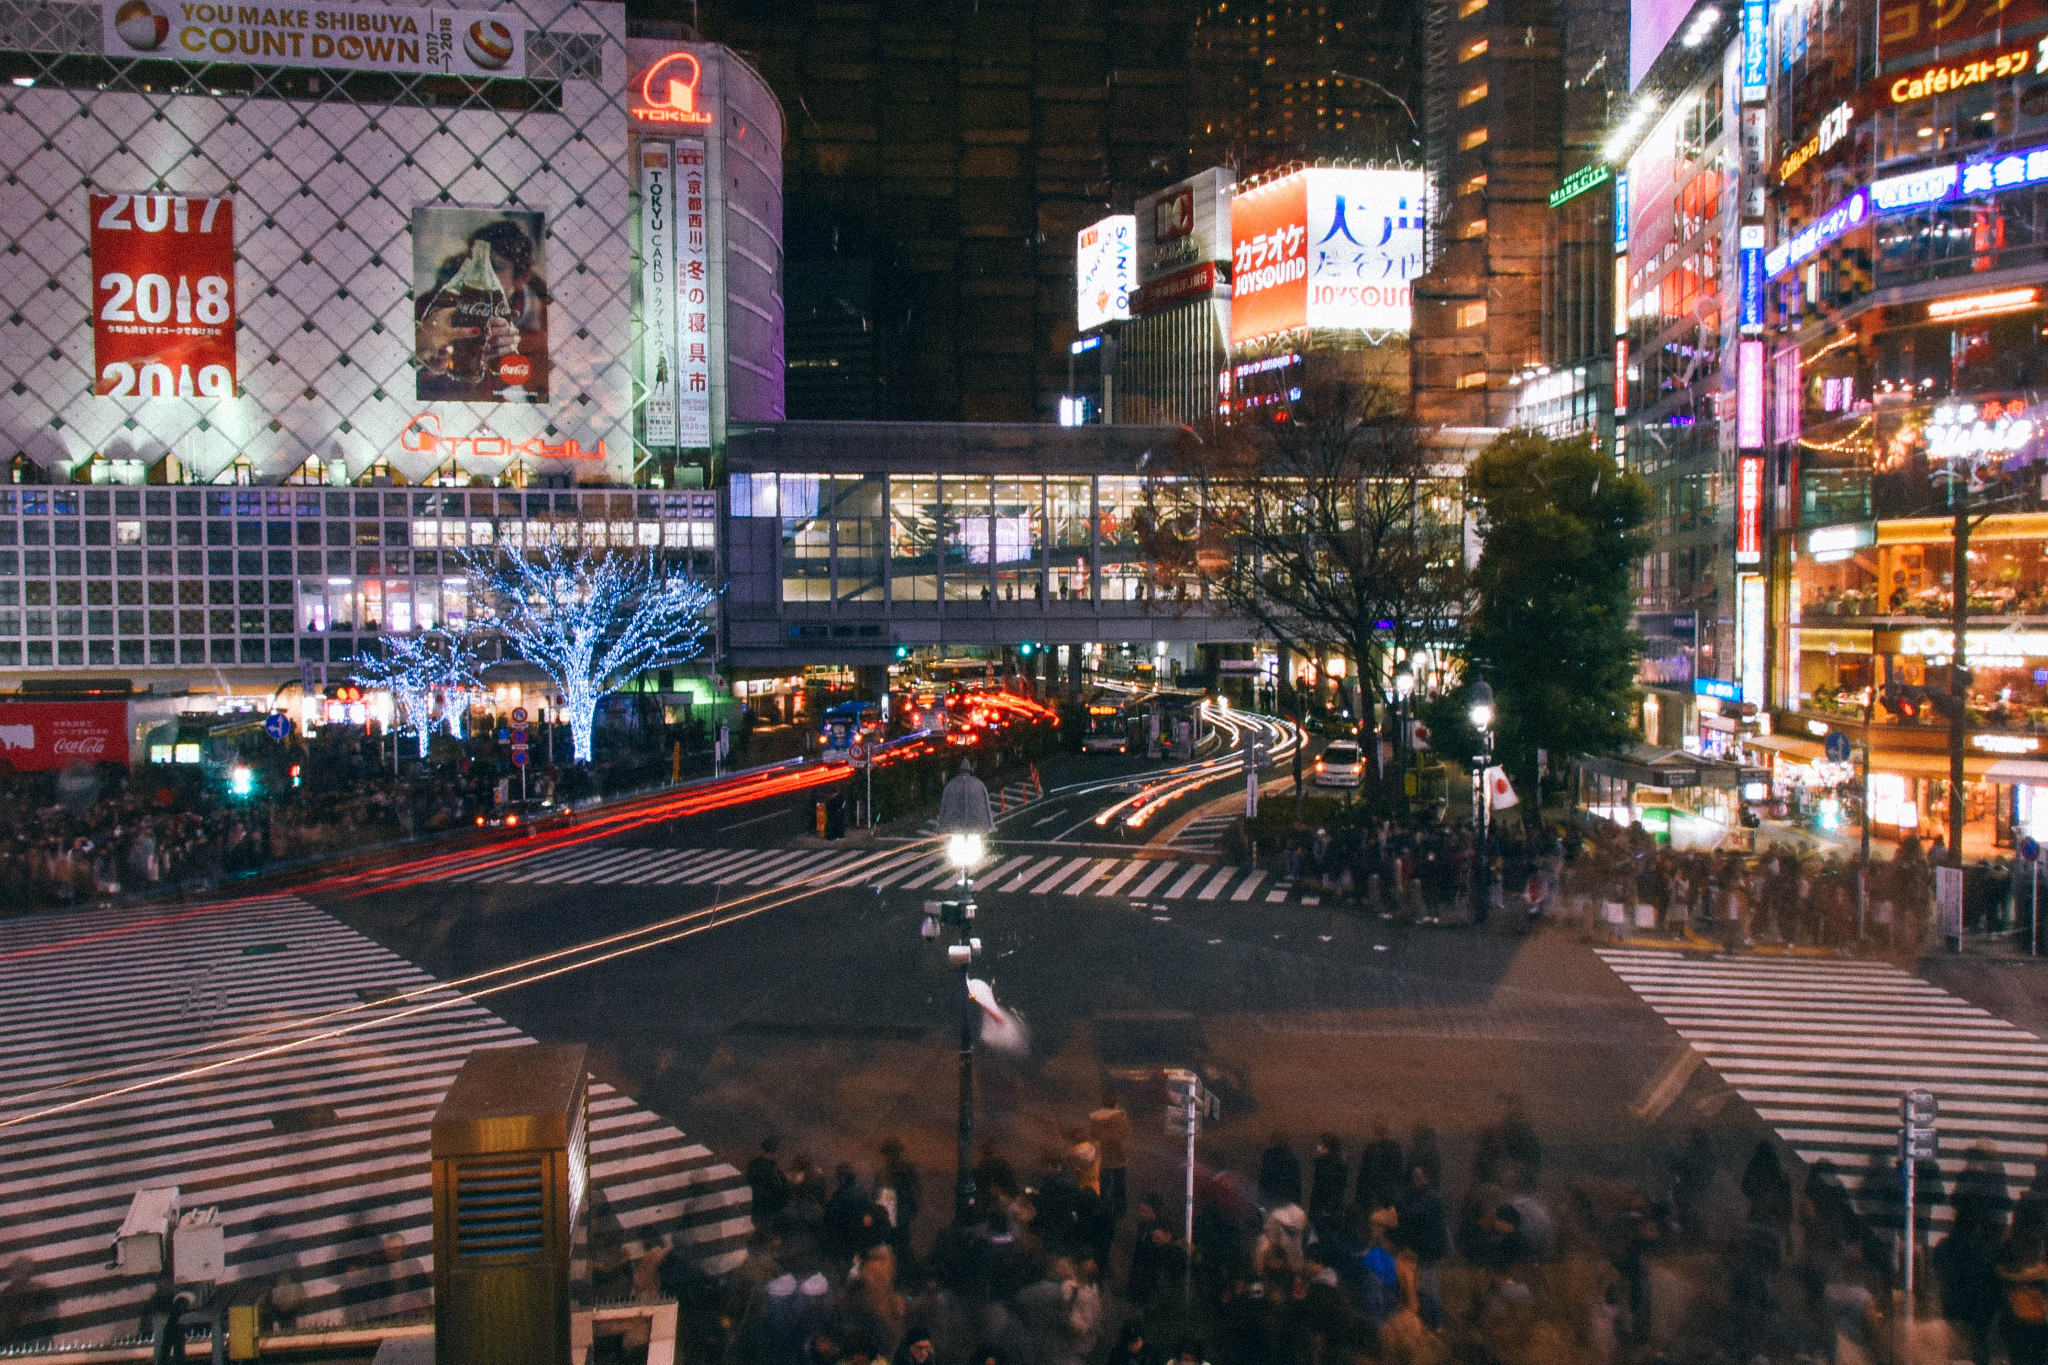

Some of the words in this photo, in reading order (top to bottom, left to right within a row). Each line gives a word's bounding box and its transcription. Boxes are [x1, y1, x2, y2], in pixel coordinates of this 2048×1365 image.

[181, 3, 233, 23] YOU
[238, 7, 308, 28] MAKE
[314, 11, 418, 35] SHIBUYA
[440, 18, 452, 50] 2018
[180, 26, 305, 57] COUNT
[312, 33, 420, 64] DOWN
[427, 33, 438, 65] 2017
[632, 107, 713, 124] TOKYU
[650, 171, 663, 231] TOKYU
[1550, 180, 1580, 204] MARK
[1580, 164, 1607, 187] CITY
[98, 195, 222, 233] 2017
[651, 234, 664, 283] CARD
[1235, 223, 1305, 273] カラオケ
[1116, 226, 1132, 310] SANKYO
[1235, 256, 1306, 298] JOYSOUND
[100, 272, 230, 324] 2018
[687, 259, 707, 392] 冬の寝具市
[102, 362, 233, 397] 2019
[443, 437, 606, 460] TOKYU
